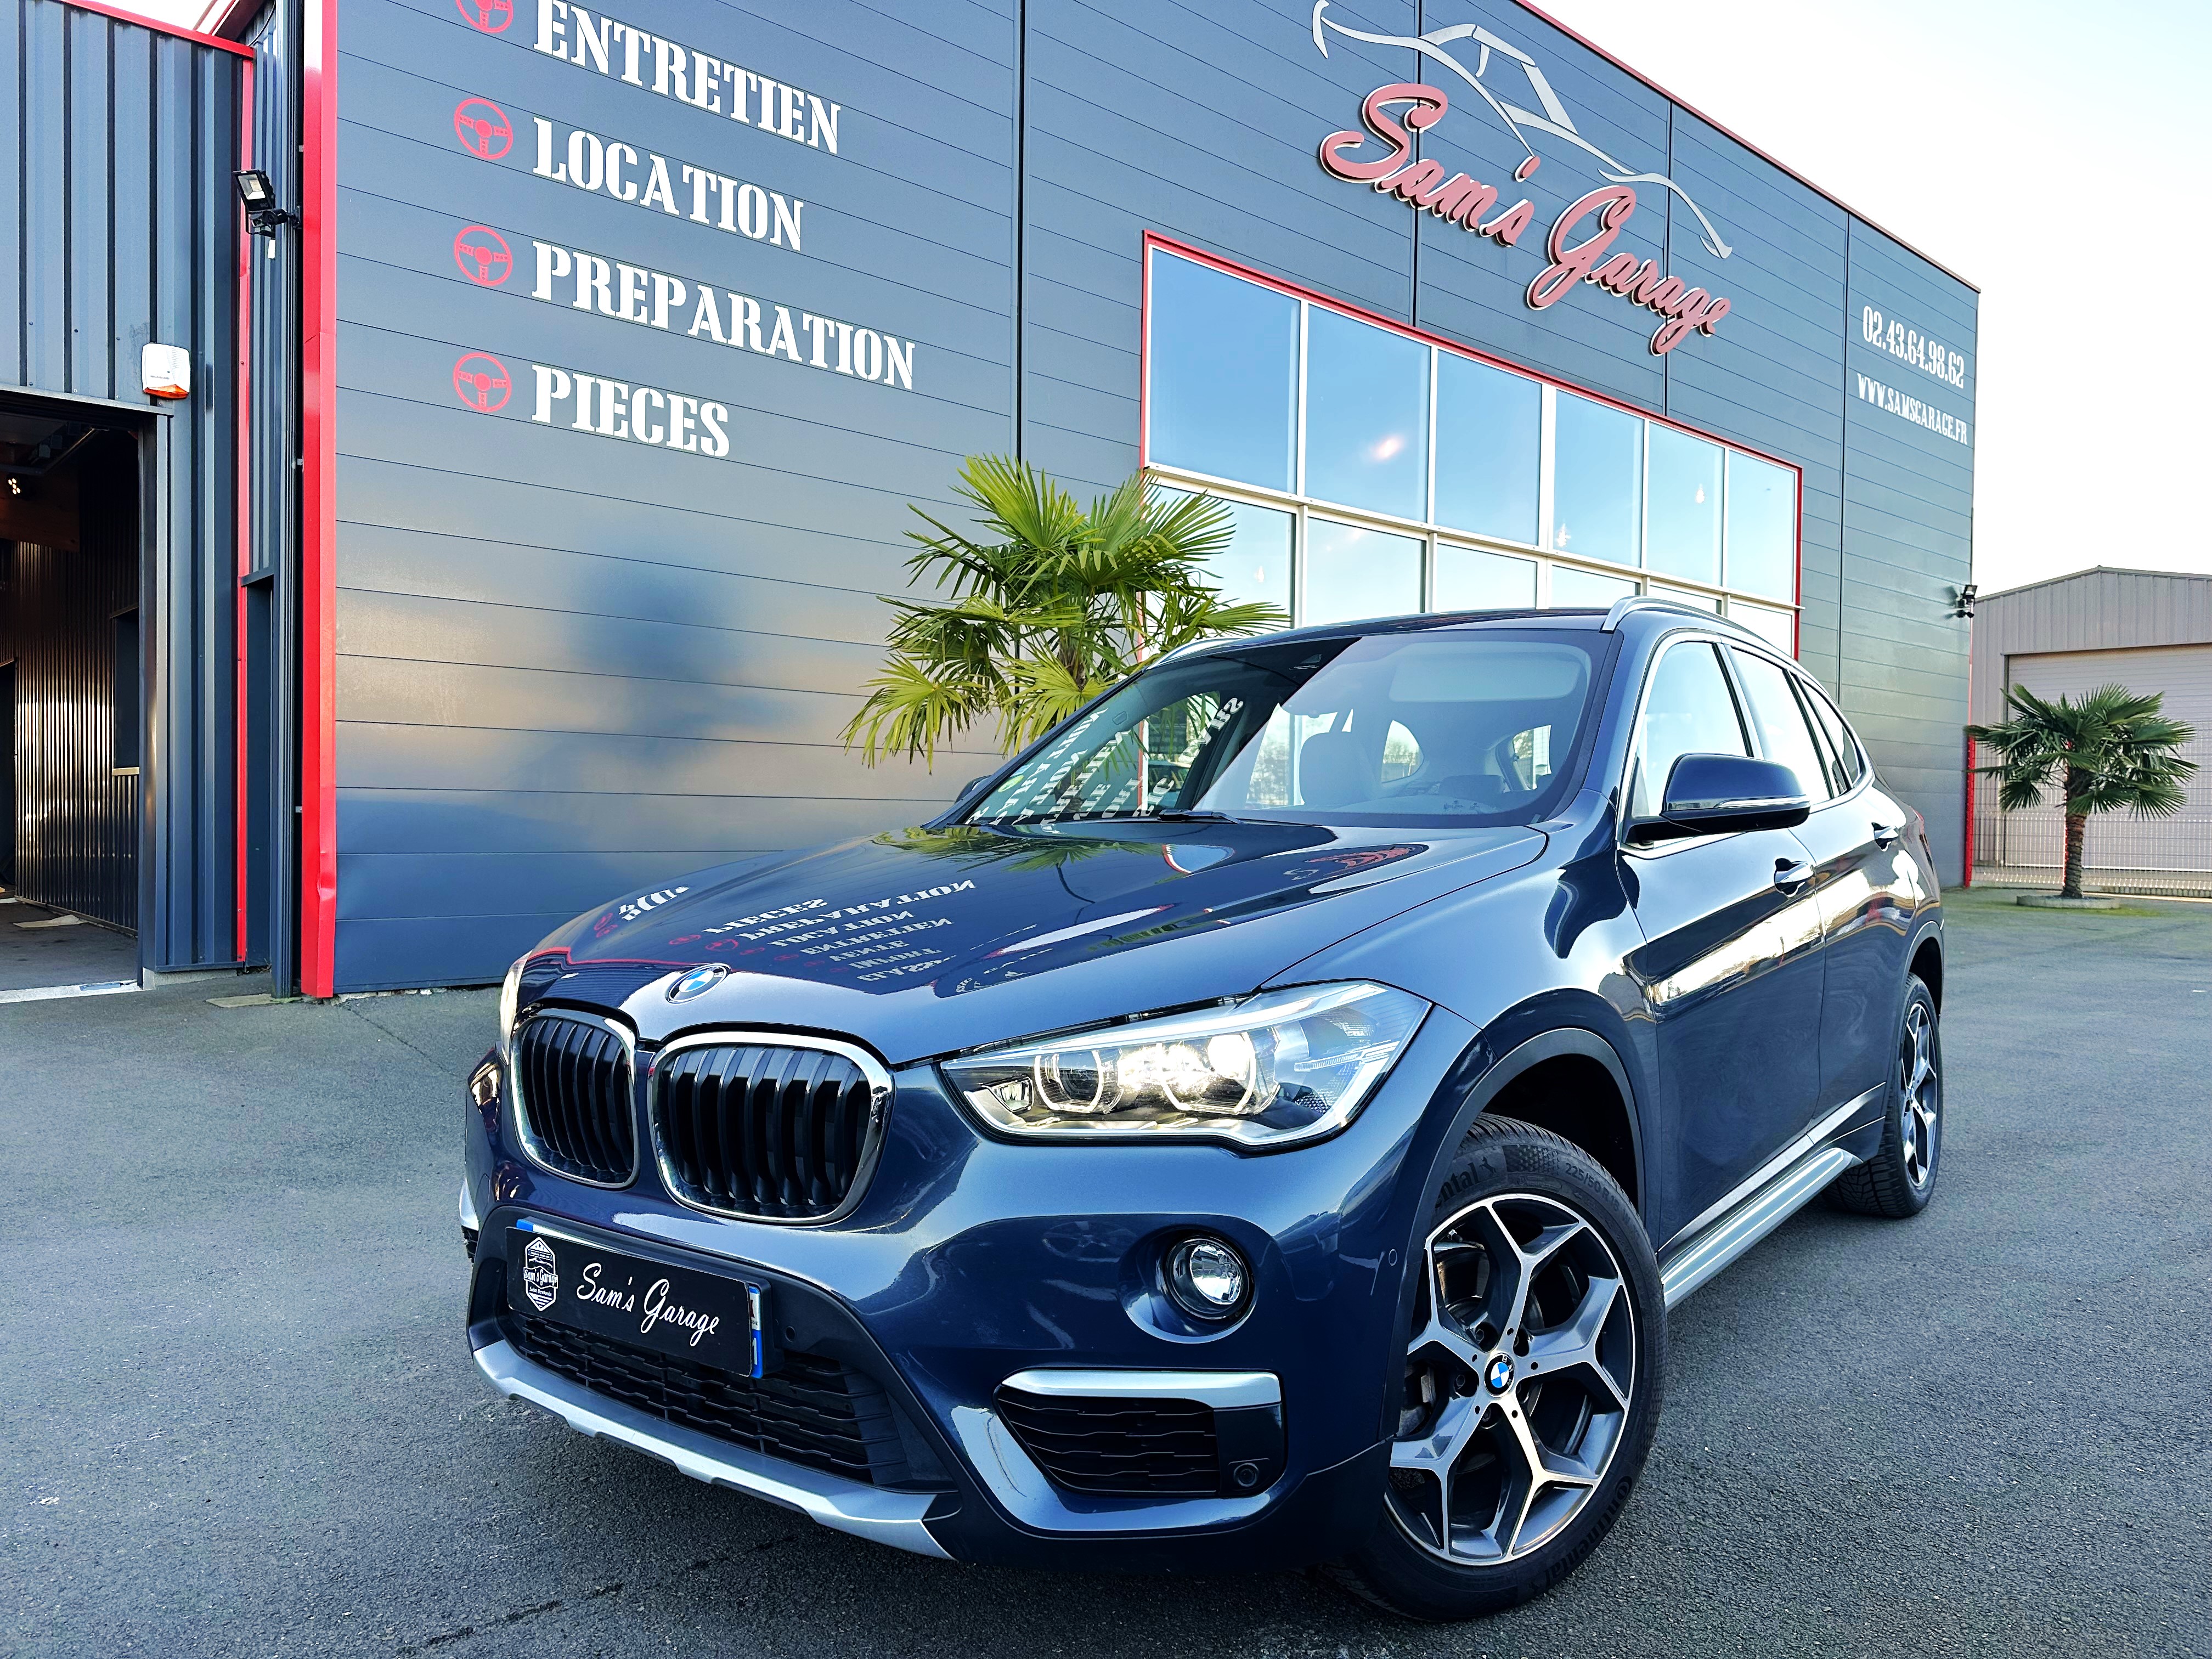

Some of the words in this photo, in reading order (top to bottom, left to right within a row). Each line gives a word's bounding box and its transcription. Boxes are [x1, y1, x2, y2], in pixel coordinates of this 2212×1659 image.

[533, 0, 841, 155] ENTRETIEN
[532, 116, 804, 251] LOCATION
[1320, 82, 1541, 247] Sam's
[1527, 185, 1731, 356] Garage
[532, 240, 915, 390] PREPARATION
[1863, 306, 1964, 389] 02.43.64.98.62
[532, 364, 730, 458] PIECES
[539, 1268, 557, 1286] Garage
[577, 1263, 635, 1312] Sam's
[640, 1279, 719, 1346] Garage
[1544, 1476, 1633, 1589] Continental
